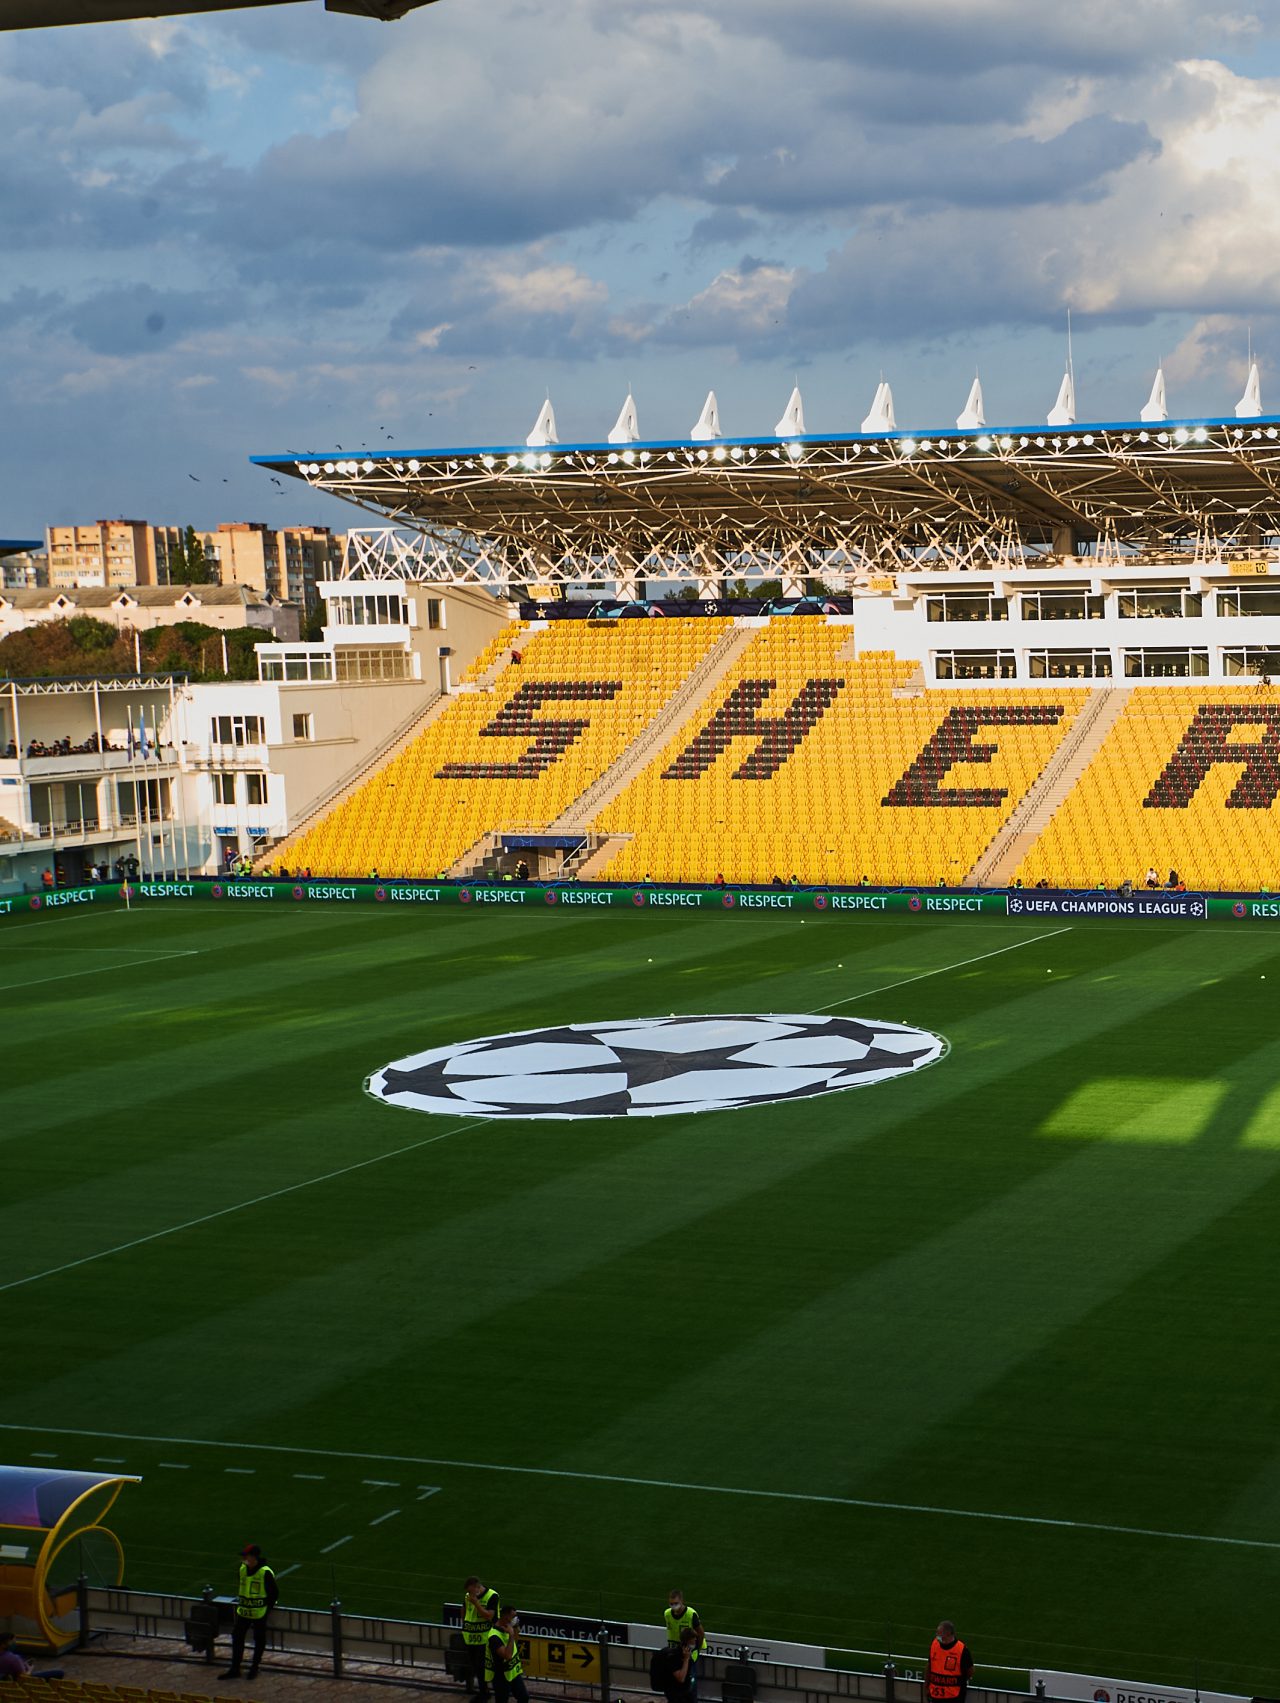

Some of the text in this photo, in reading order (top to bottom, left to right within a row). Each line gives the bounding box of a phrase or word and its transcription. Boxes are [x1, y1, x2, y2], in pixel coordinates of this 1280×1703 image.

[1256, 563, 1266, 573] 10
[552, 588, 559, 596] 8
[140, 885, 194, 896] RESPECT
[227, 886, 274, 897] RESPECT
[308, 887, 357, 900] RESPECT
[390, 888, 441, 901] RESPECT
[475, 890, 526, 903] RESPECT
[46, 889, 95, 906] RESPECT
[561, 892, 613, 904] RESPECT
[649, 893, 703, 906] RESPECT
[739, 894, 794, 908] RESPECT
[832, 896, 888, 909] RESPECT
[926, 898, 983, 911] RESPECT
[1026, 901, 1187, 914] UEFA CHAMPIONS LEAGUE
